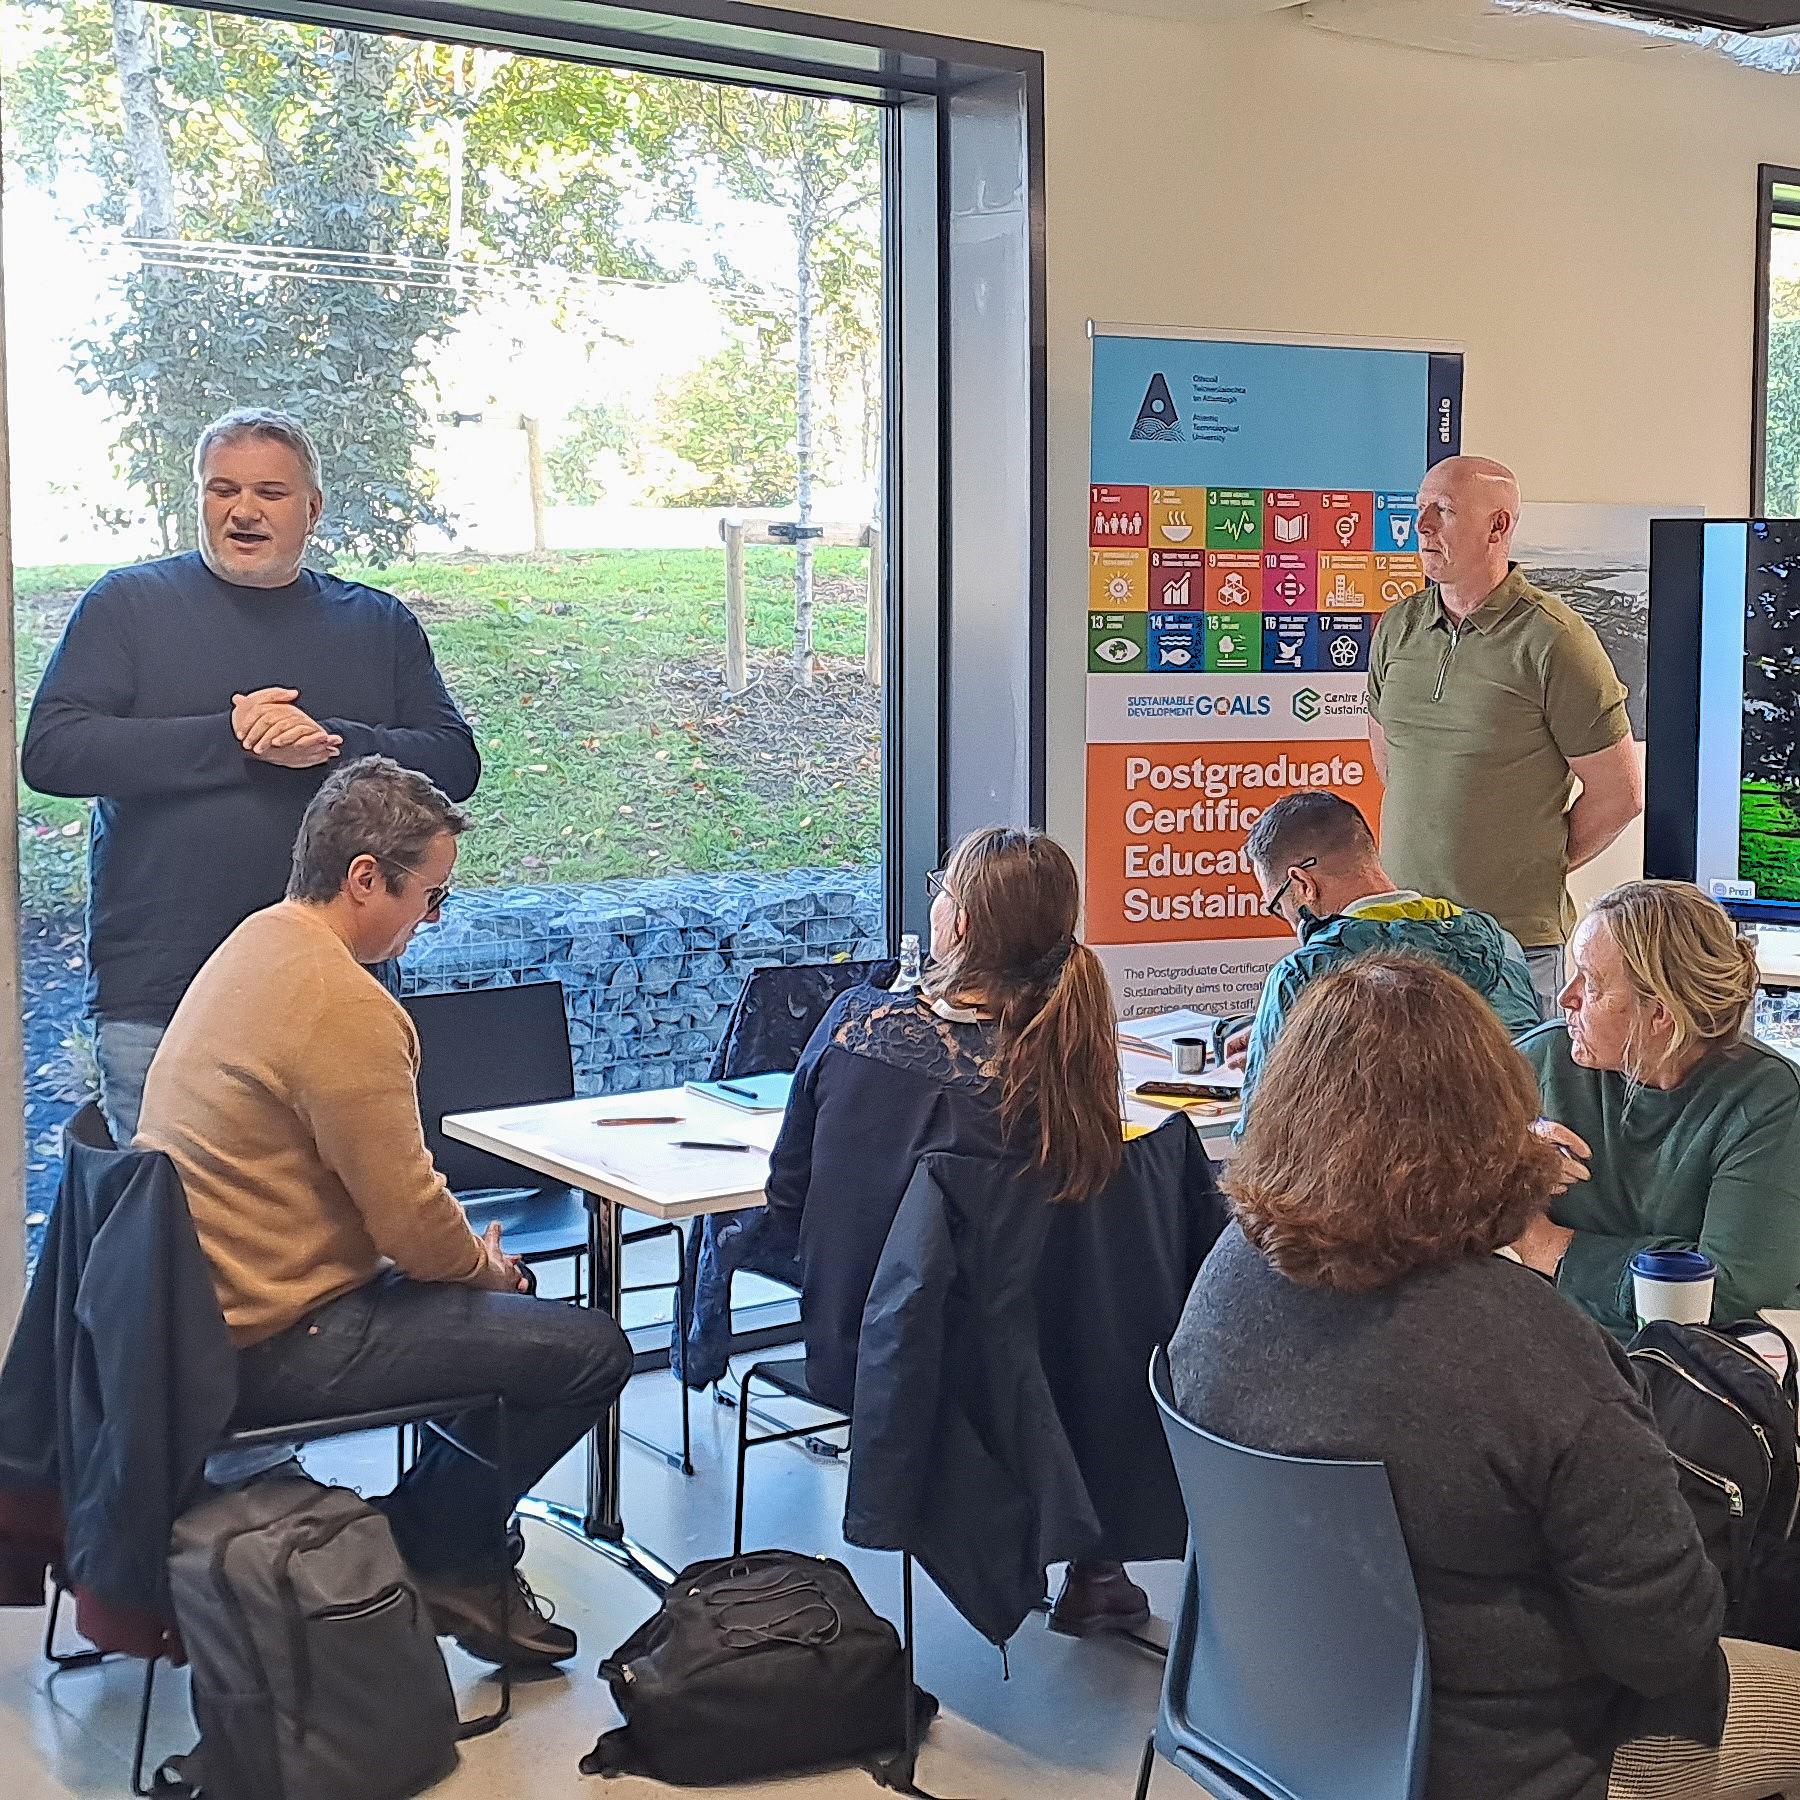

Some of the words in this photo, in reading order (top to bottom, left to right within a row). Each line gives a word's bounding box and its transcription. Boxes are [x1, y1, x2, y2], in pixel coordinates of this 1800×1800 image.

[1092, 488, 1098, 503] 1
[1153, 490, 1161, 504] 2
[1209, 491, 1217, 505] 3
[1267, 492, 1275, 507] 4
[1322, 494, 1330, 508] 5
[1377, 495, 1385, 509] 6
[1092, 552, 1100, 566] 7
[1152, 552, 1160, 567] 8
[1208, 554, 1216, 568] 9
[1265, 554, 1277, 569] 10
[1320, 555, 1330, 569] 11
[1375, 556, 1387, 570] 12
[1091, 615, 1104, 629] 13
[1150, 615, 1163, 629] 14
[1207, 616, 1219, 629] 15
[1264, 616, 1277, 630] 16
[1320, 616, 1331, 630] 17
[1127, 696, 1195, 707] SUSTAINABLE
[1324, 693, 1358, 703] Centre
[1127, 707, 1194, 717] DEVELOPMENT
[1195, 695, 1271, 716] GOALS
[1125, 754, 1364, 798] Postgraduate
[1124, 968, 1145, 980] The
[1146, 964, 1218, 981] Postgraduate
[1123, 983, 1194, 998] Sustainability
[1195, 982, 1221, 994] aims
[1223, 982, 1234, 993] to
[1123, 1004, 1135, 1016] of
